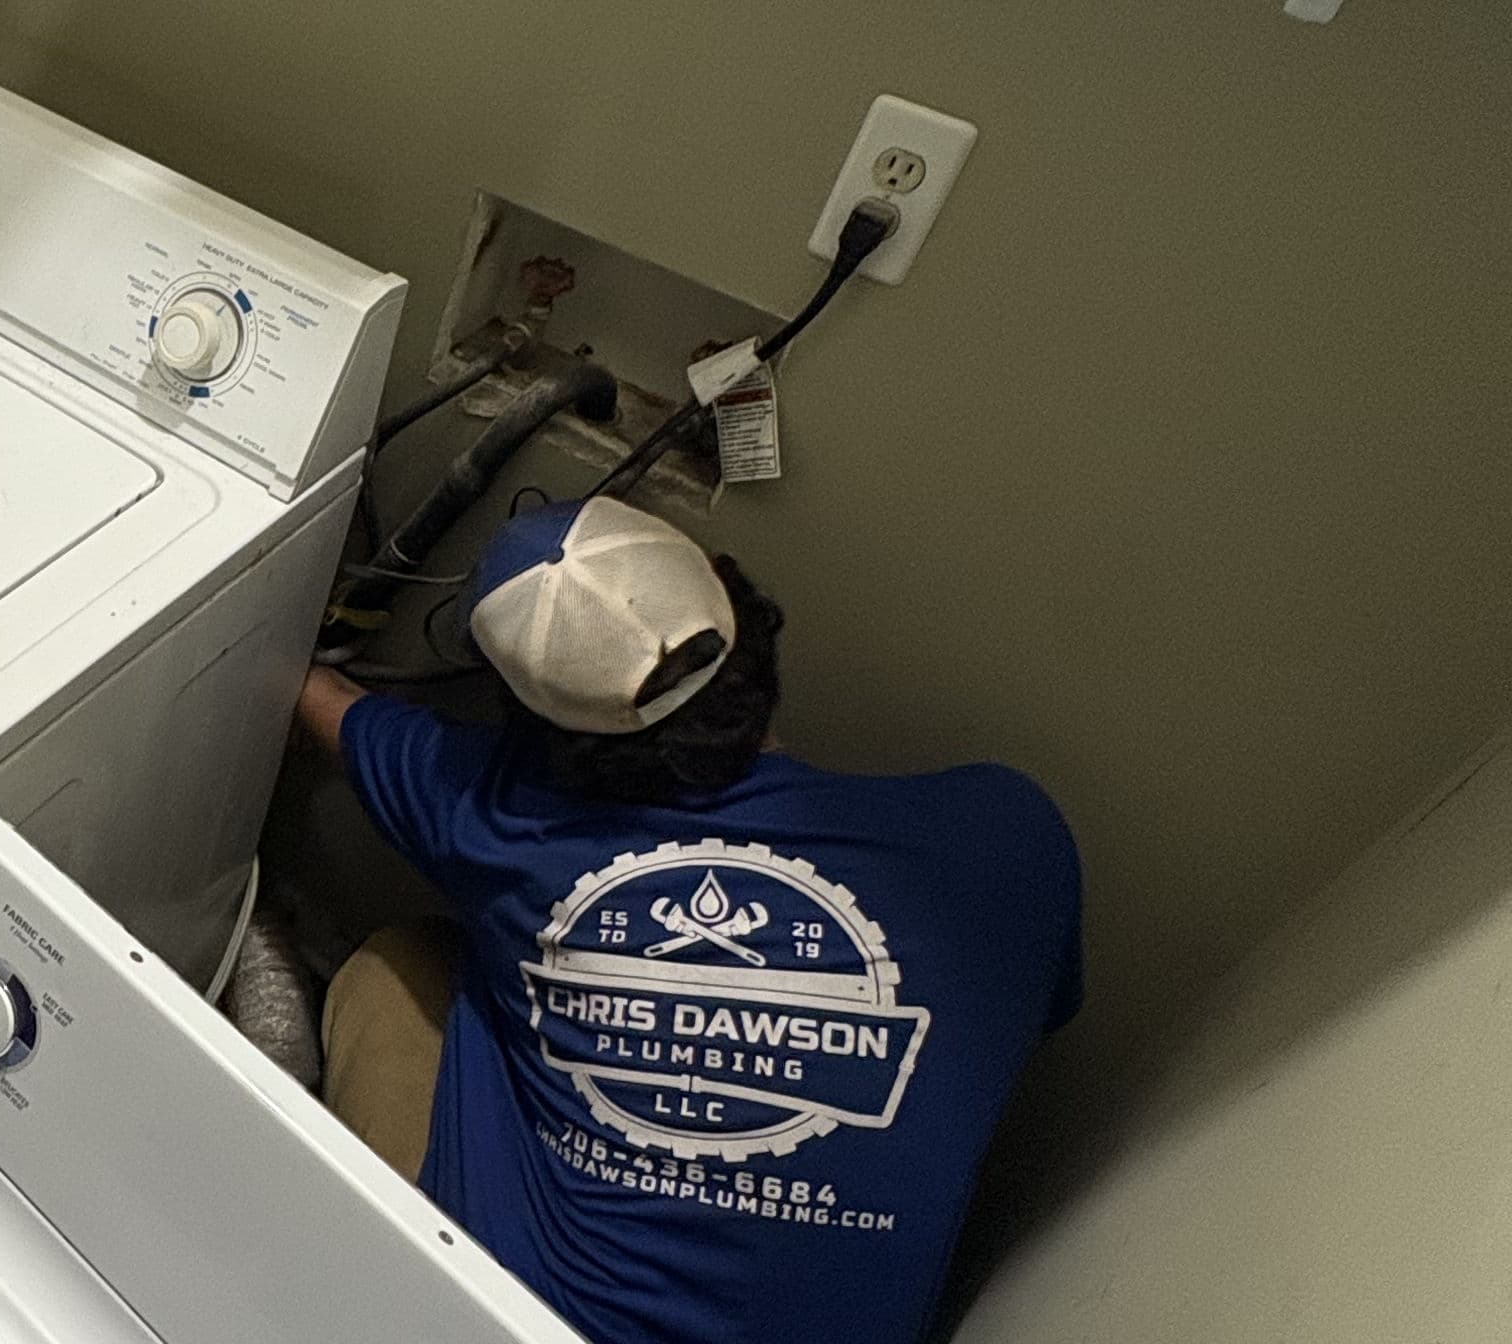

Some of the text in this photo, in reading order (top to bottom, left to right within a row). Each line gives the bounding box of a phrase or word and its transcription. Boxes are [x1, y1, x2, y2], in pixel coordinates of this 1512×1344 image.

[2, 903, 66, 967] FABRIC CARE
[598, 928, 628, 944] TD
[600, 911, 629, 927] ES
[791, 921, 824, 940] 20
[792, 942, 821, 959] 19
[547, 984, 889, 1060] CHRIS DAWSON
[595, 1034, 805, 1082] PLUMBING
[654, 1093, 725, 1123] LLC
[536, 1120, 896, 1232] CHRISDAWSONPLUMBING.COM
[559, 1121, 838, 1207] 706-436-6684
